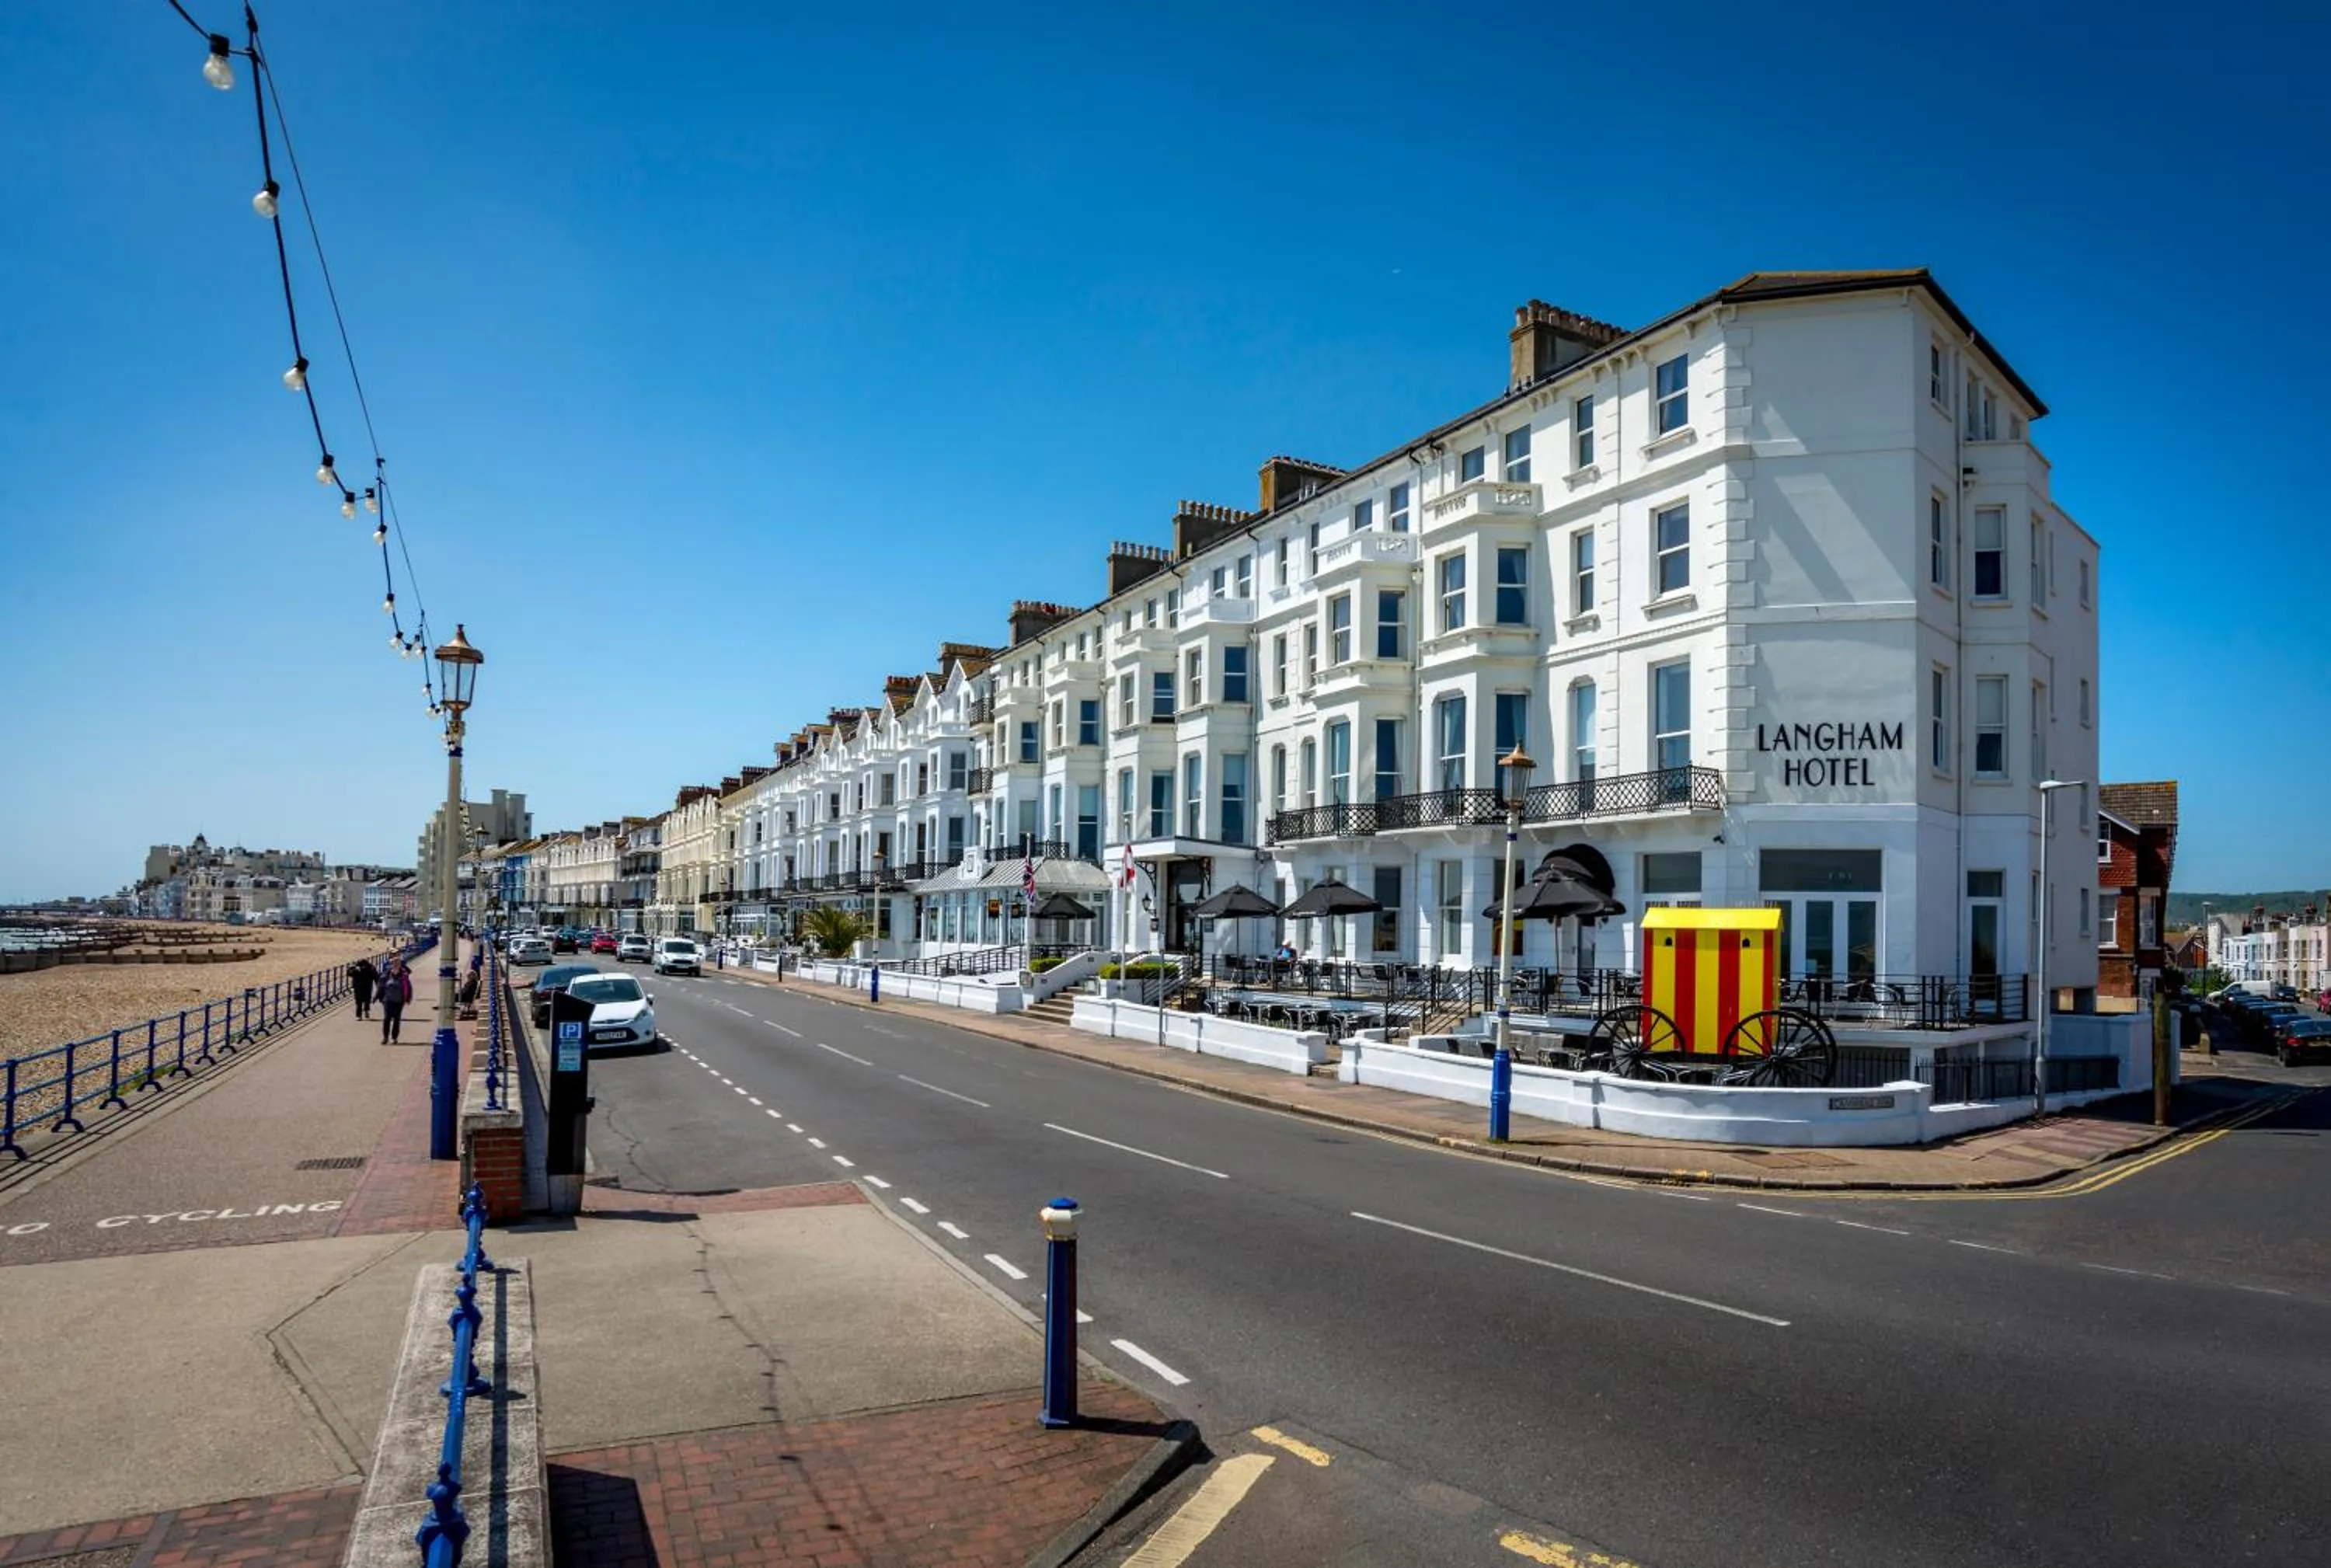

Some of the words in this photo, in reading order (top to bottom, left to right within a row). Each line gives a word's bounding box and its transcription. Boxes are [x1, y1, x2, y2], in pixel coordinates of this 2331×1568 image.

[1758, 722, 1903, 751] LANGHAM
[1785, 758, 1875, 787] HOTEL
[566, 1025, 577, 1038] P
[0, 1222, 51, 1235] O
[96, 1200, 343, 1228] CYCLING
